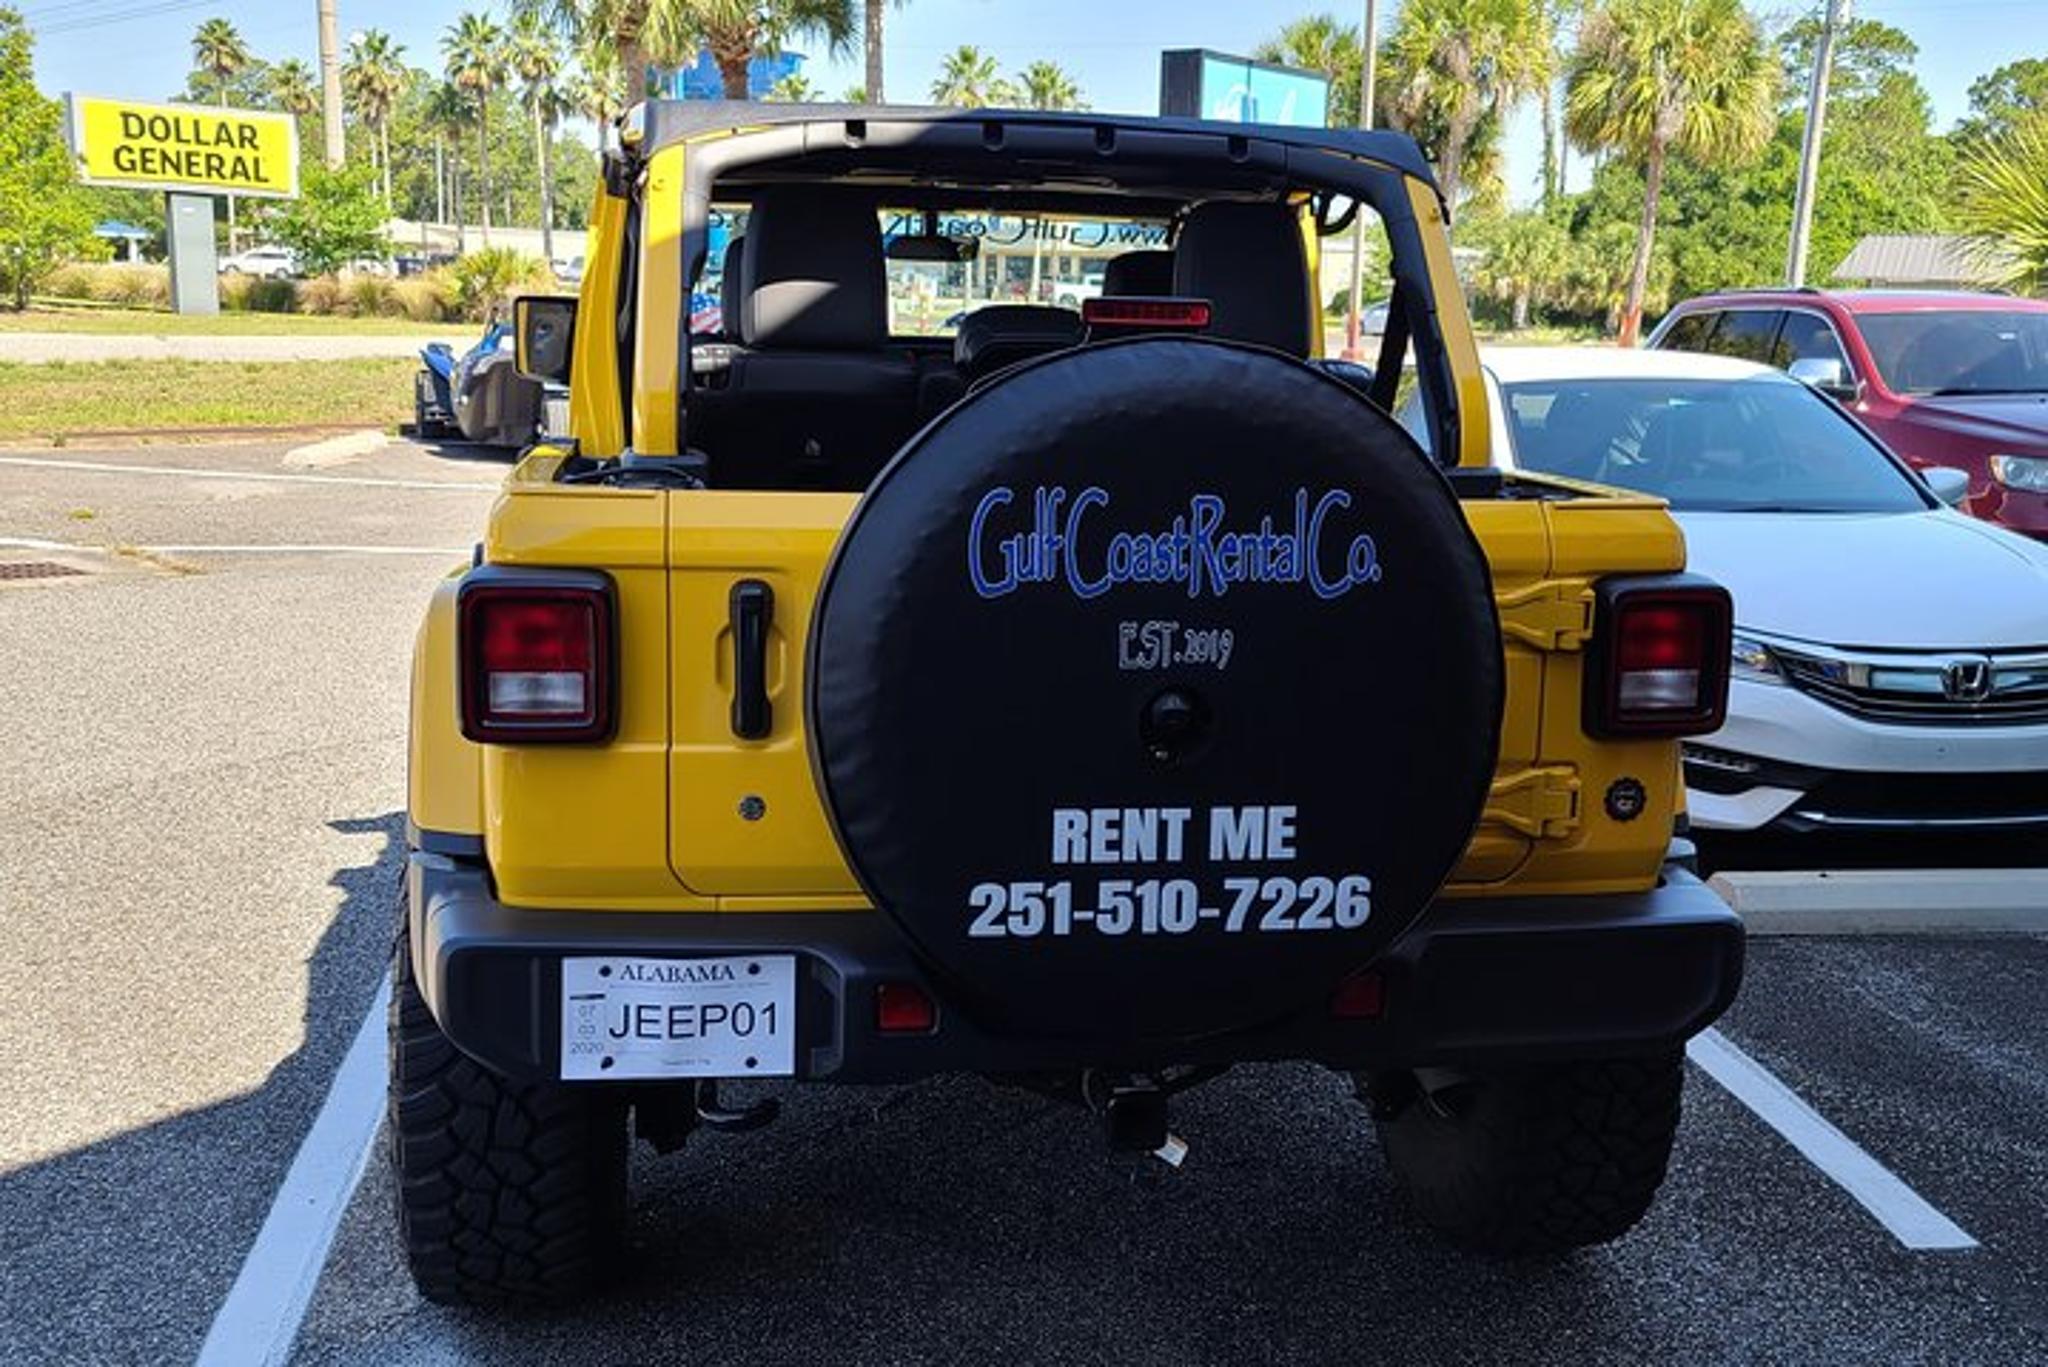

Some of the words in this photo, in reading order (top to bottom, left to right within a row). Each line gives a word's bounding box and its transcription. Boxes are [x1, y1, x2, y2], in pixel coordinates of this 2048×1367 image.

[120, 111, 260, 150] DOLLAR
[113, 144, 270, 183] GENERAL
[1052, 808, 1191, 863] RENT
[1209, 805, 1297, 861] ME
[968, 875, 1372, 937] 251-510-7226
[620, 964, 735, 982] ALABAMA
[609, 1001, 776, 1039] JEEP01
